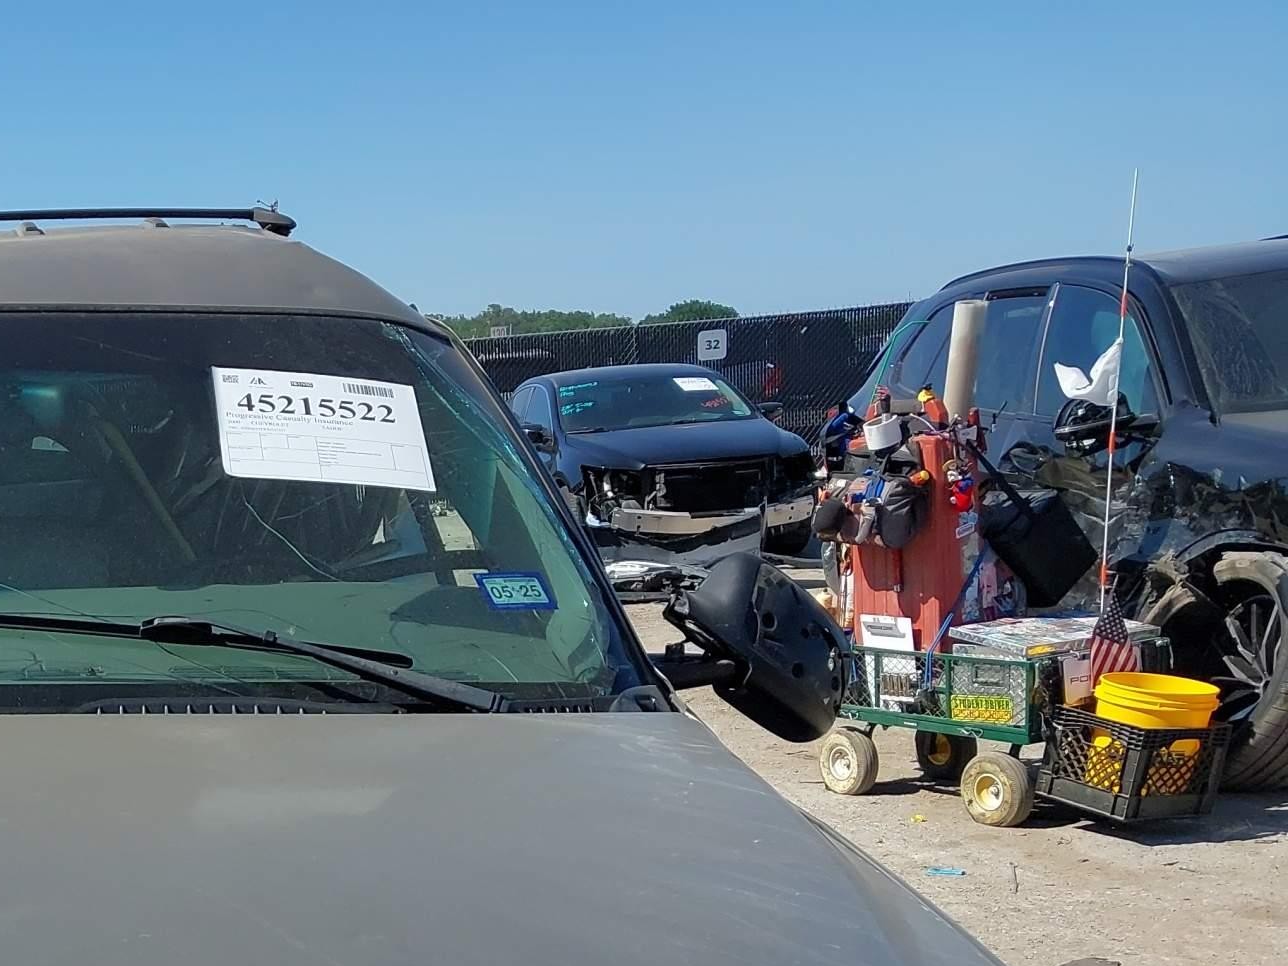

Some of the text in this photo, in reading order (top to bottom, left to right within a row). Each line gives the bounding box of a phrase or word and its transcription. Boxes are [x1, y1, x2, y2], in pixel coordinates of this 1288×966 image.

[704, 339, 721, 350] 32
[237, 392, 395, 424] 45215522
[225, 411, 354, 426] Progressive Casualty Insurance
[953, 699, 1010, 711] STUDENT DRIVER
